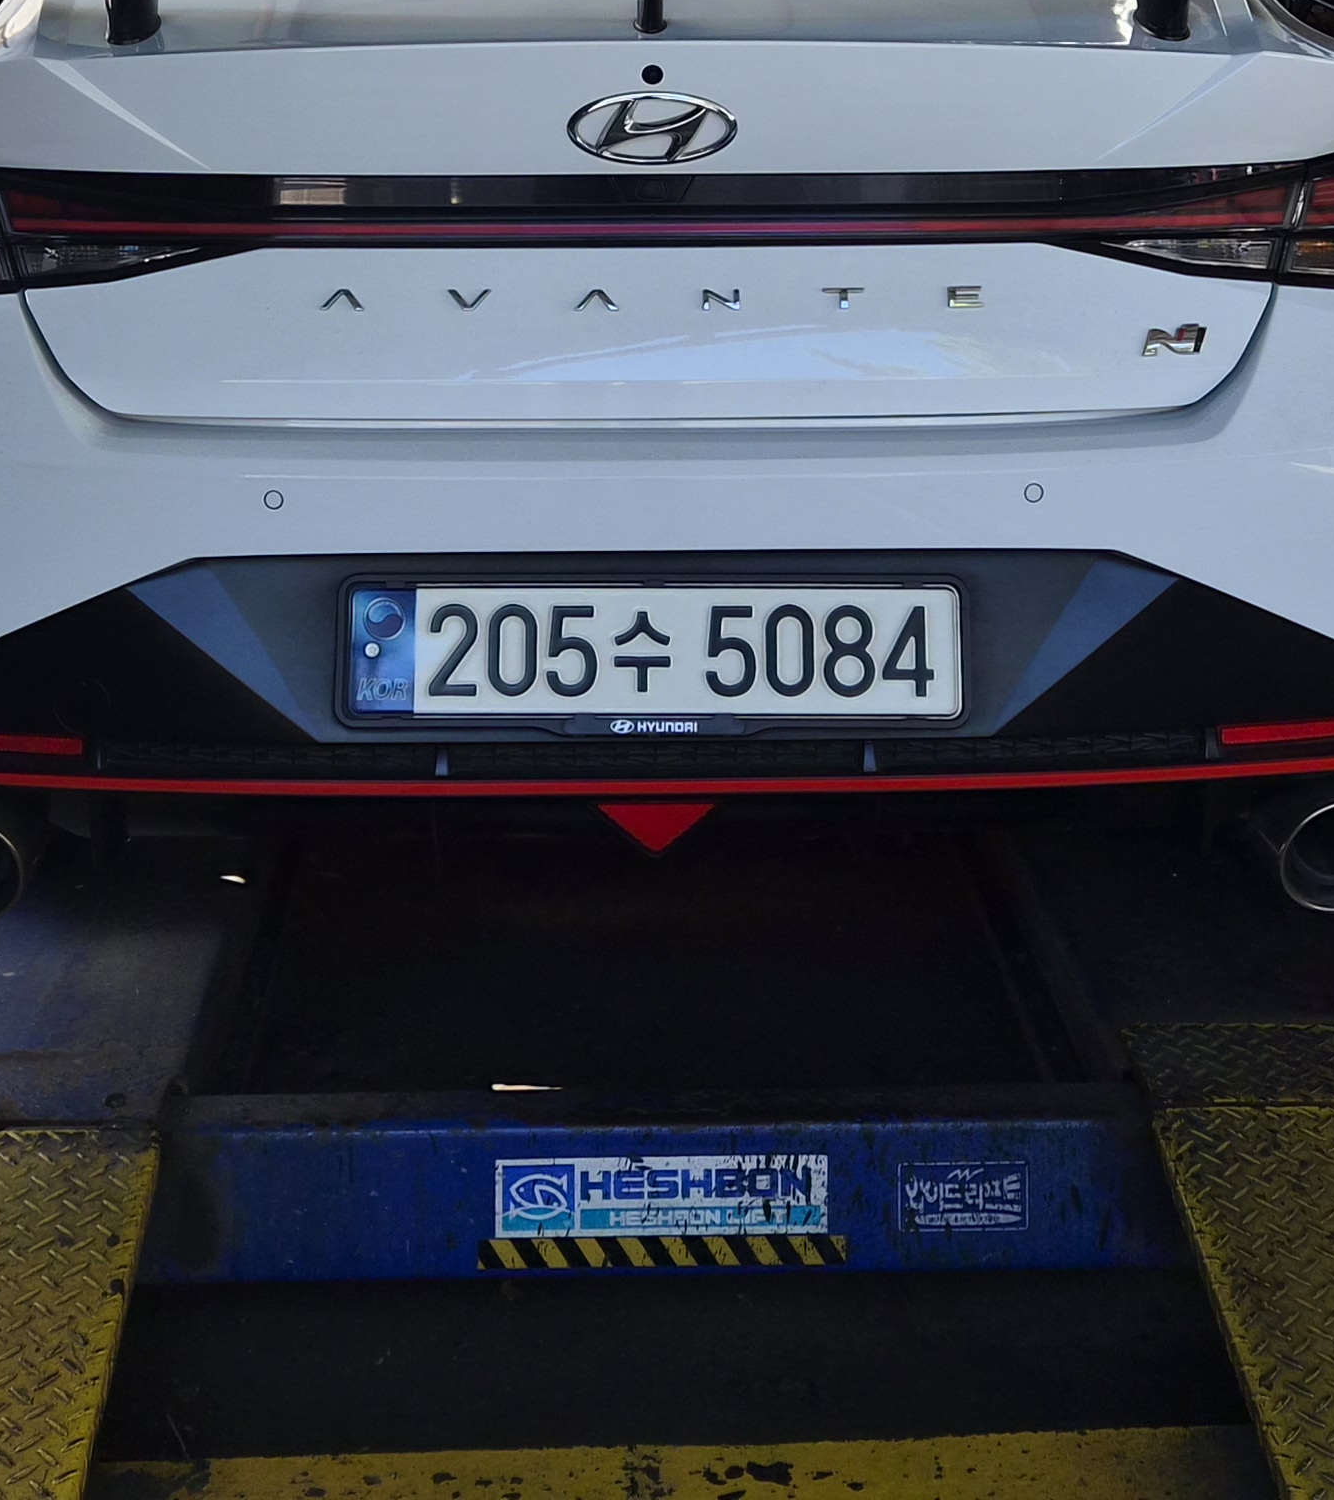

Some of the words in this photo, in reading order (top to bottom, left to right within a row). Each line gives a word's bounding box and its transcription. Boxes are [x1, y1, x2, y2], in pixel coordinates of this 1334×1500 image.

[319, 284, 985, 313] AVANTE
[427, 603, 672, 699] 205수
[705, 604, 935, 699] 5084
[356, 677, 409, 702] KOR
[636, 720, 699, 734] HYUNDAI
[579, 1168, 812, 1202] HESHBON
[609, 1208, 722, 1227] HESHBON
